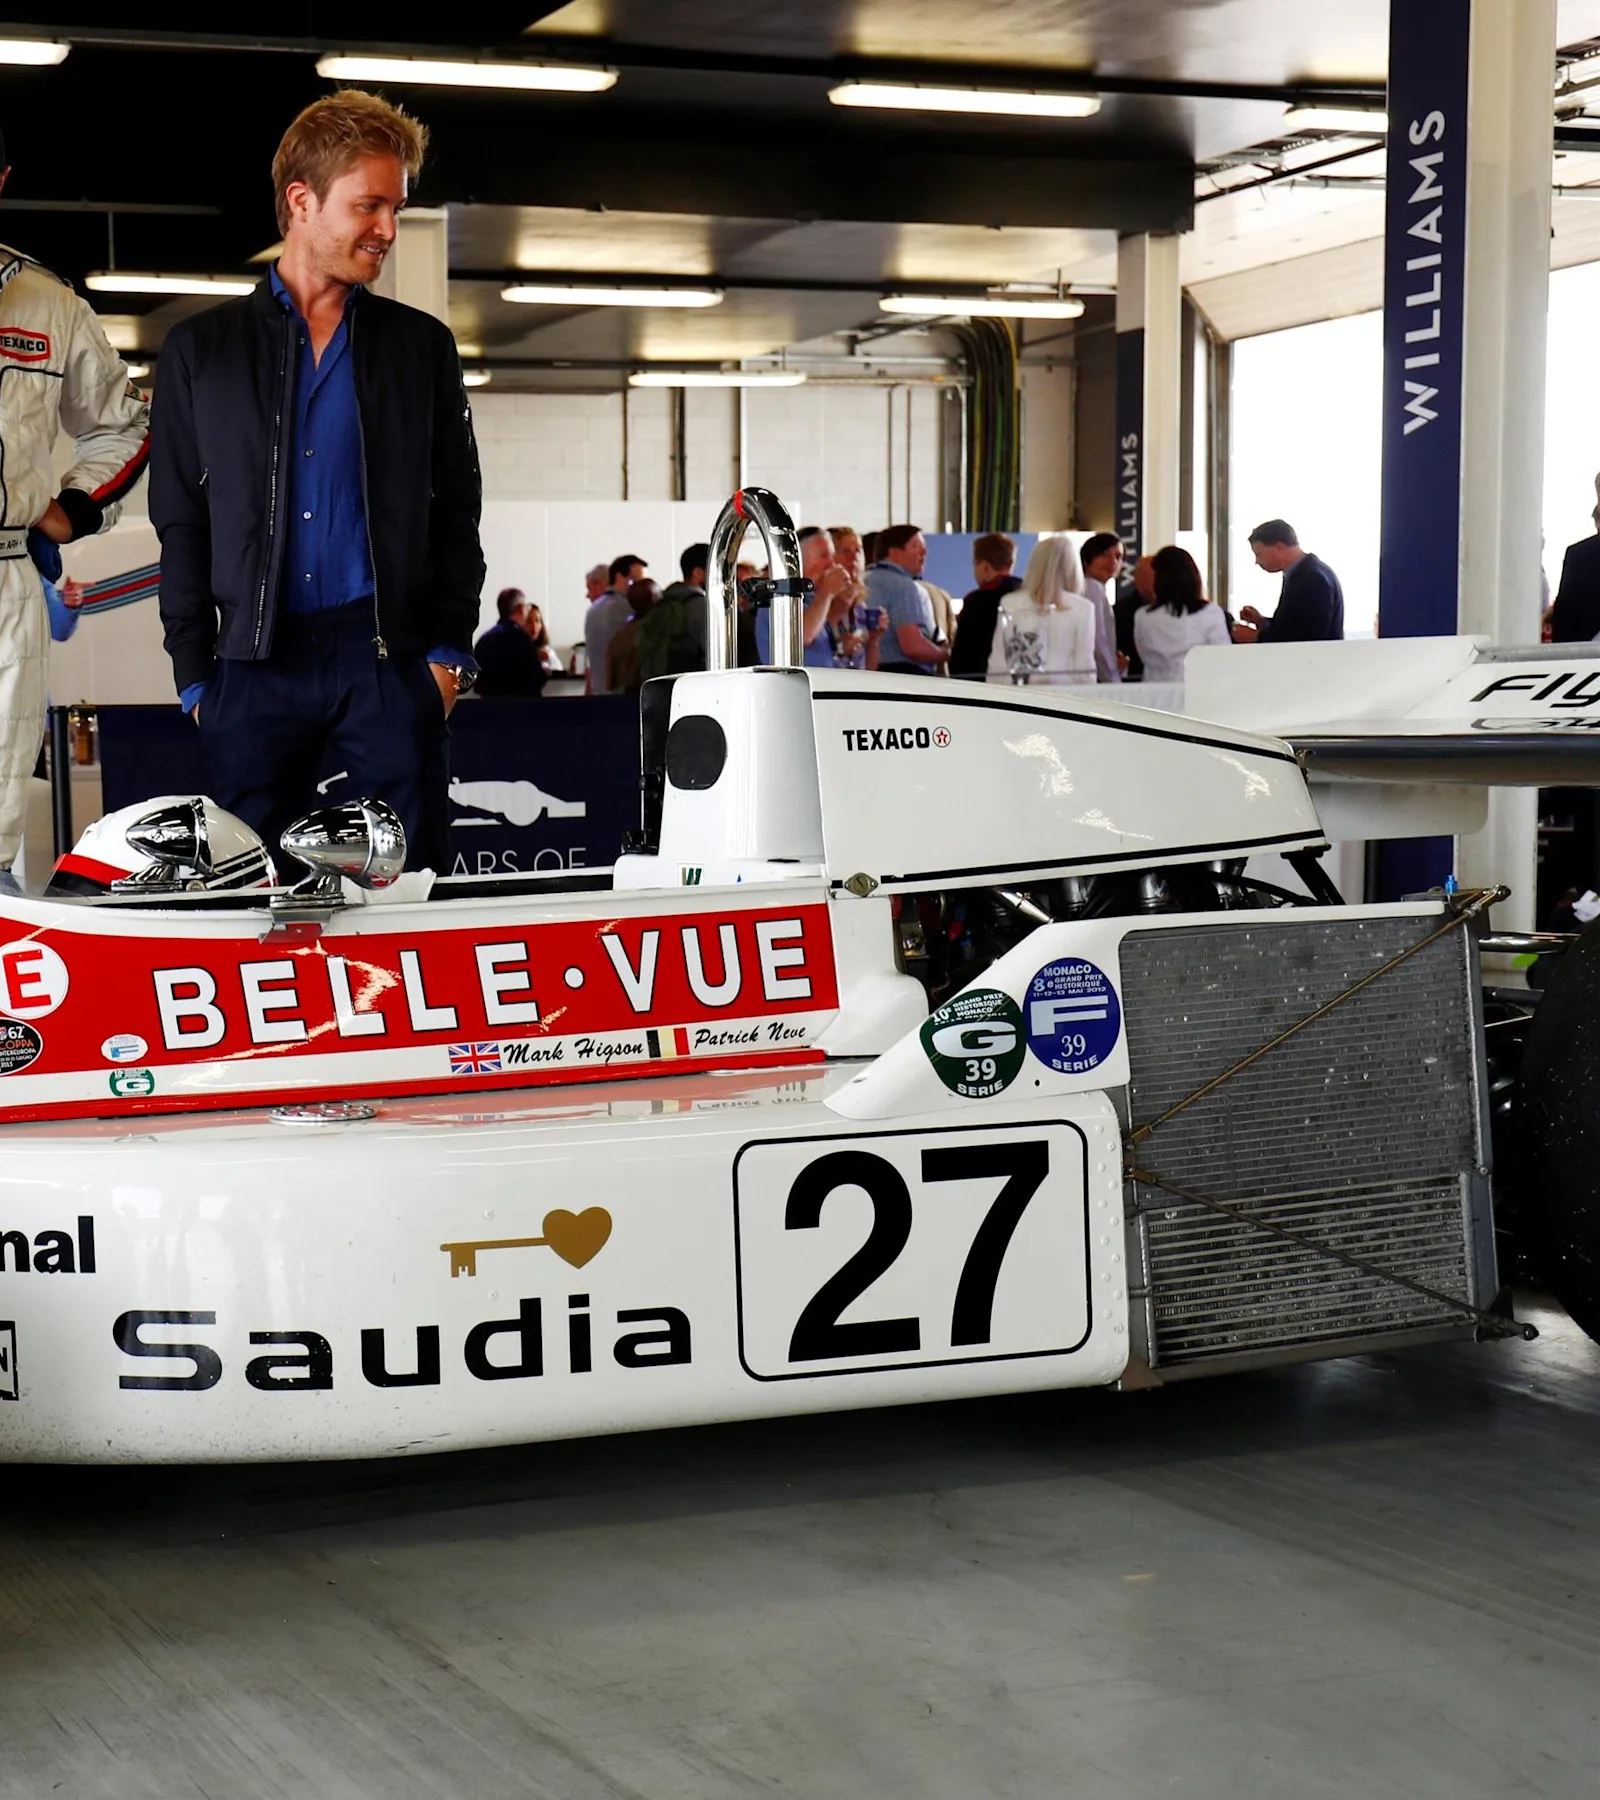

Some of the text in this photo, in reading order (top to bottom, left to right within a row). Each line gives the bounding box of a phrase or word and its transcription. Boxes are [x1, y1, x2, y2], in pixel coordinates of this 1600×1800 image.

[1403, 110, 1445, 436] WILLIAMS
[1120, 432, 1138, 588] WILLIAMS
[842, 727, 930, 751] TEXACO
[2, 949, 52, 1010] E
[1044, 964, 1091, 977] MONACO
[1055, 975, 1082, 984] GRAND
[1055, 981, 1100, 990] HISTORIQUE
[953, 996, 981, 1008] GRAND
[954, 999, 1003, 1012] HISTORIQUE
[957, 1007, 993, 1017] MONACO
[1030, 995, 1109, 1036] F
[695, 1022, 806, 1050] Patrick Neve
[932, 1021, 1016, 1058] G
[1061, 1034, 1087, 1057] 39
[503, 1037, 644, 1066] Mark Higson
[1052, 1054, 1099, 1071] SERIE
[965, 1058, 997, 1082] 39
[116, 1078, 150, 1093] G
[957, 1079, 1004, 1097] SERIE
[785, 1140, 1050, 1363] 27
[112, 1293, 693, 1391] Saudia
